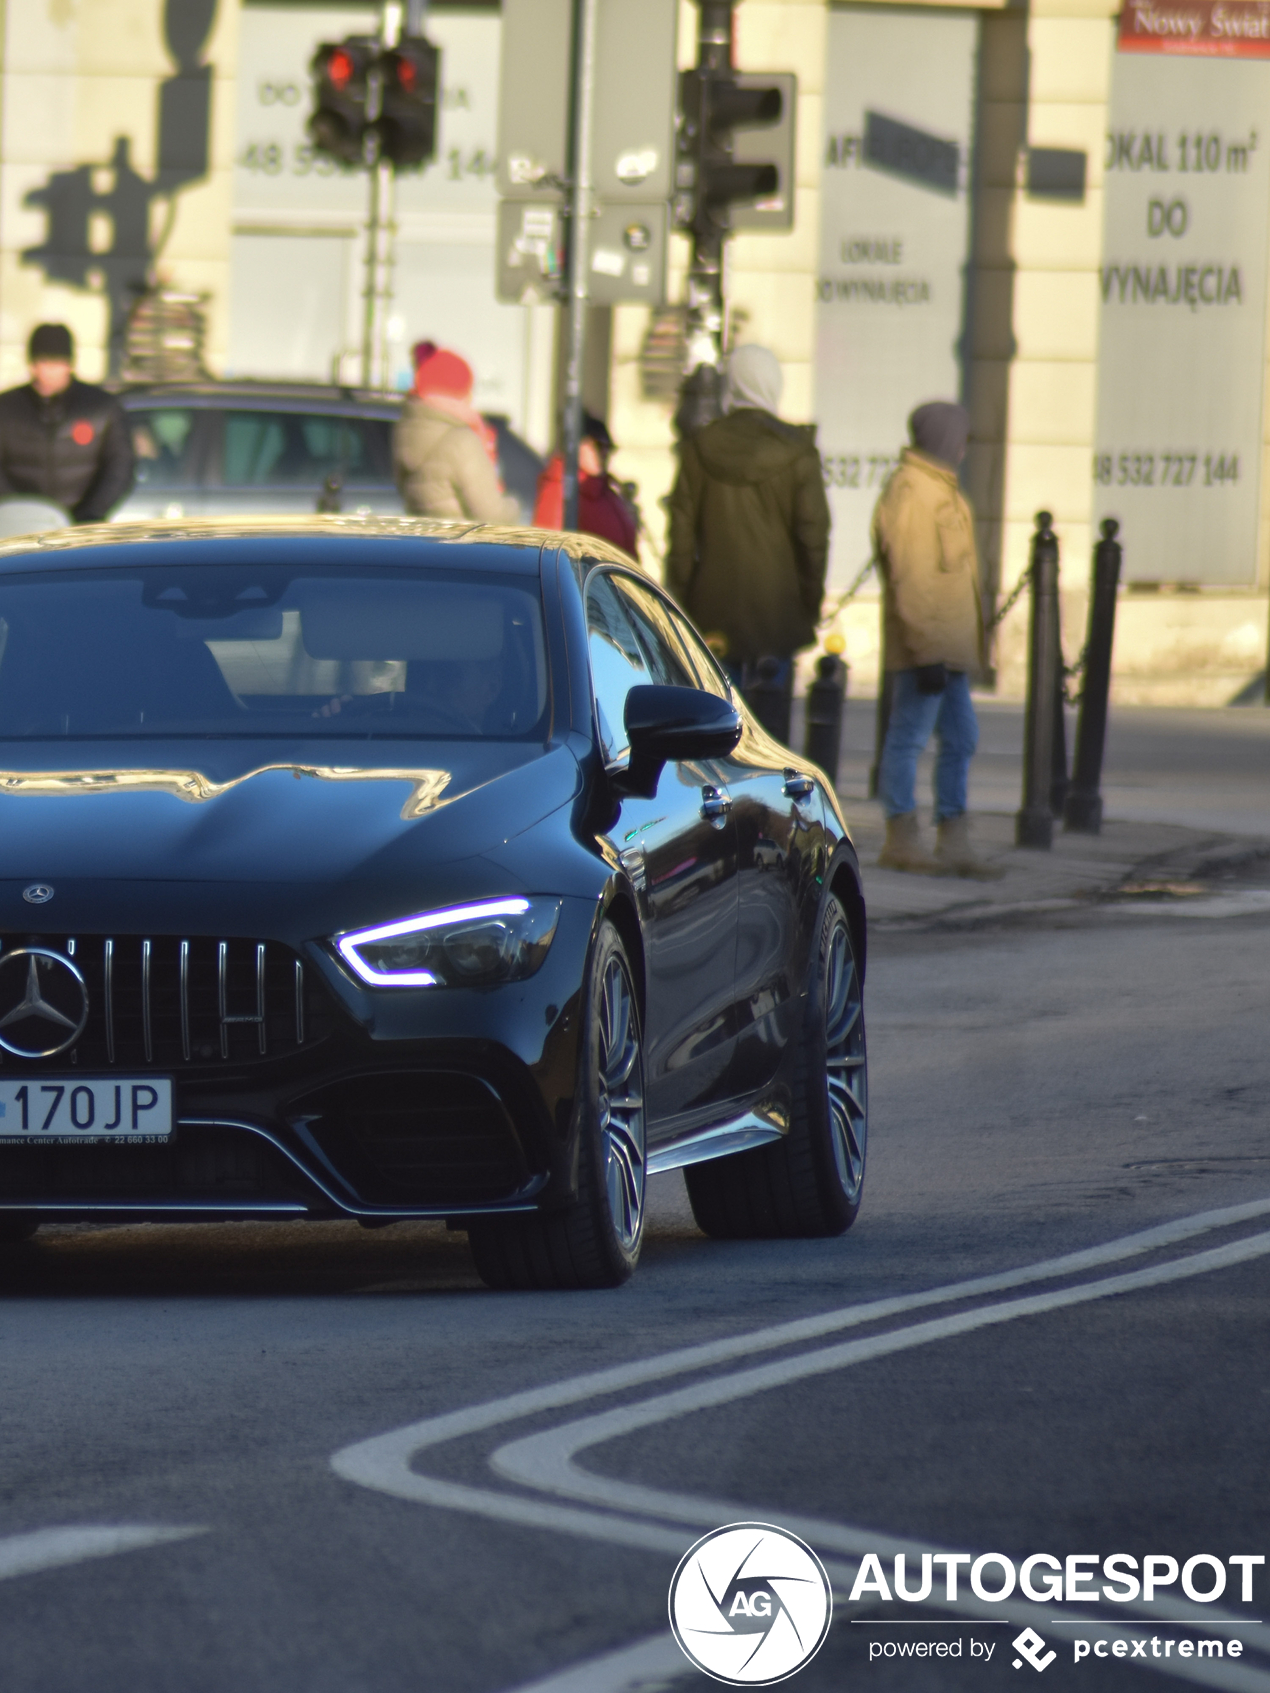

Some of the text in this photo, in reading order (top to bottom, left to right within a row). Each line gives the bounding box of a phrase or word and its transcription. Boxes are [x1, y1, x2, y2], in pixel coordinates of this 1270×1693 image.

[1134, 4, 1270, 43] Nowy Świat
[1178, 133, 1221, 172] 110
[1147, 199, 1187, 237] DO
[1118, 453, 1154, 486] 532
[1161, 453, 1198, 486] 727
[1203, 453, 1238, 486] 144
[14, 1085, 159, 1131] 170JP
[27, 1136, 54, 1145] Center
[56, 1136, 99, 1145] Autotrade
[114, 1136, 125, 1144] 22
[127, 1136, 143, 1144] 660
[145, 1136, 156, 1144] 33
[158, 1135, 169, 1144] 00
